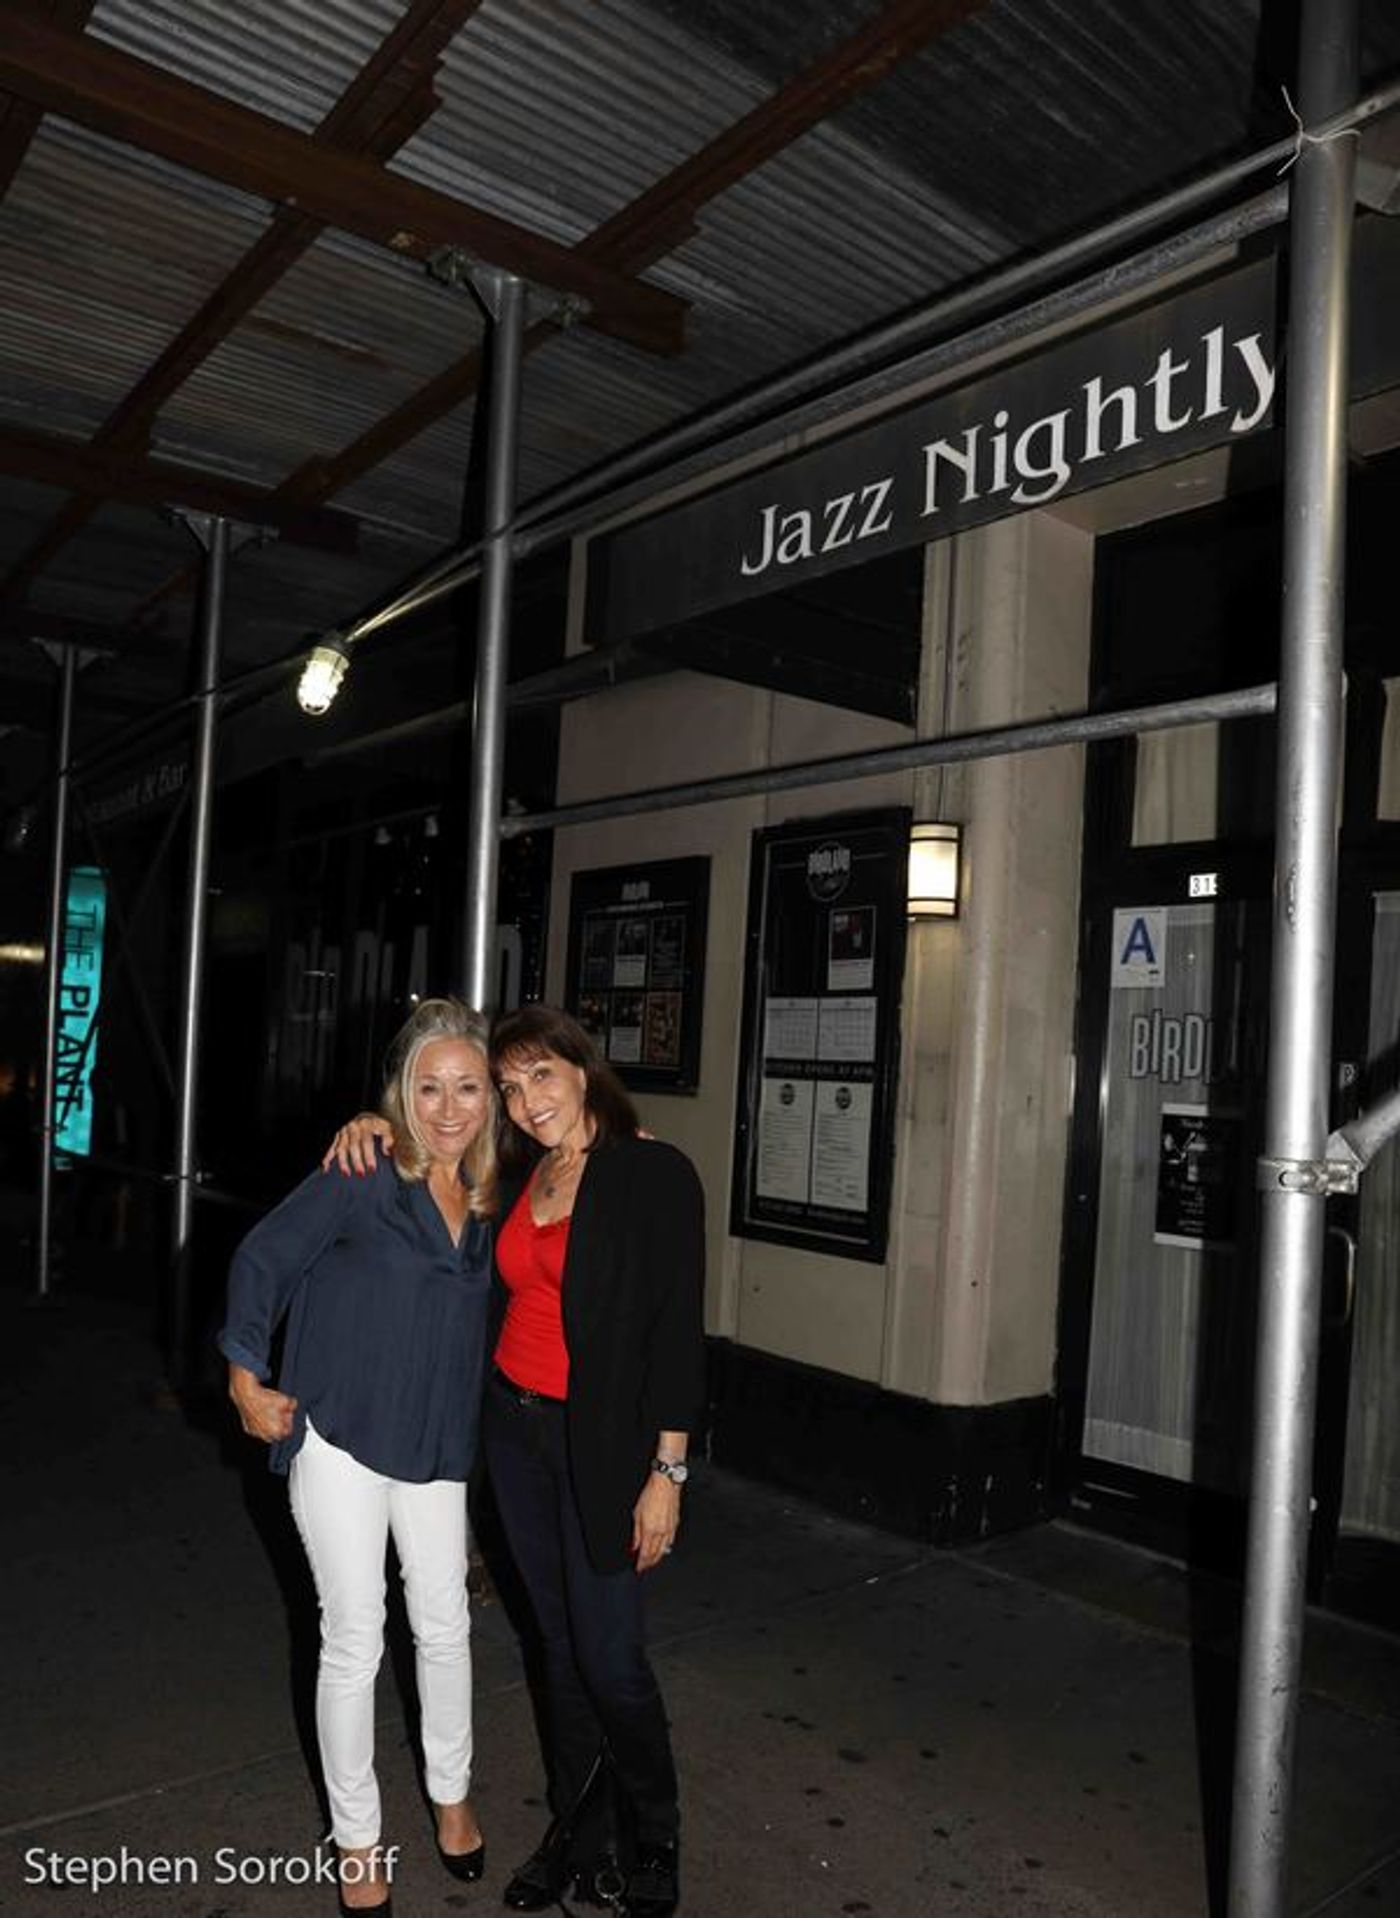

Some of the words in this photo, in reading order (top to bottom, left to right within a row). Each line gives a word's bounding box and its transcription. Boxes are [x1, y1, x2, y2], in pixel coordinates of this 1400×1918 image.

[741, 475, 896, 576] Jazz
[919, 325, 1276, 516] Nightly
[66, 902, 97, 972] THE
[1120, 916, 1156, 965] A
[54, 983, 91, 1112] PLANT
